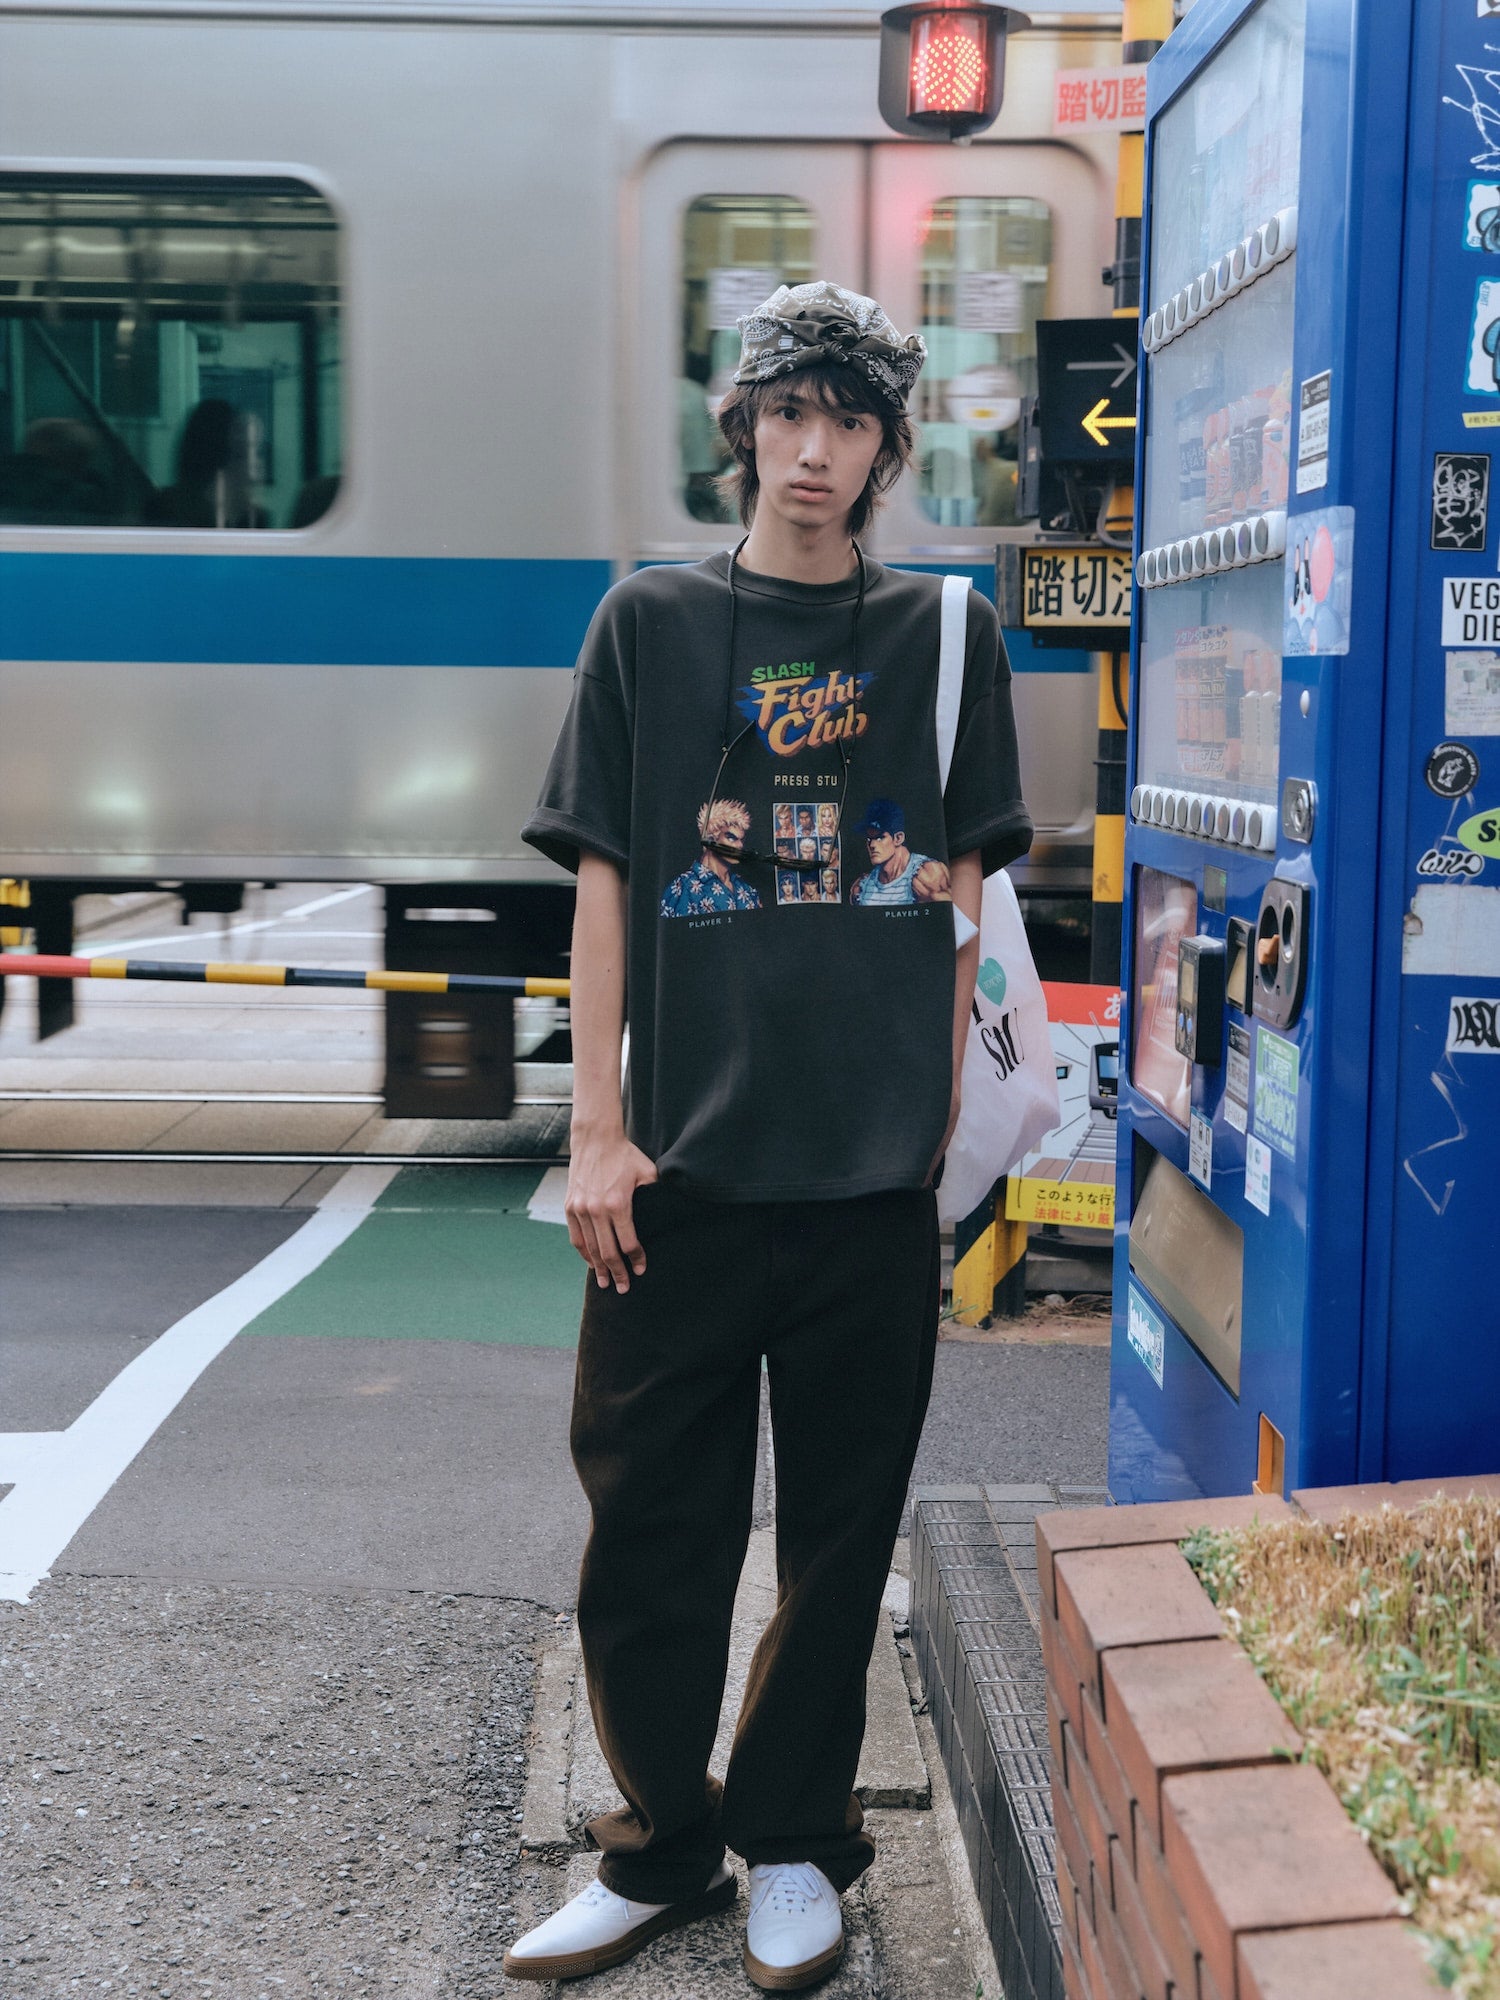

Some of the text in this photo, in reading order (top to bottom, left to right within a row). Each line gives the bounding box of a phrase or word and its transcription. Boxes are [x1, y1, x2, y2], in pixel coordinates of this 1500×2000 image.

[1449, 582, 1500, 610] VEG
[751, 661, 815, 683] SLASH
[751, 670, 864, 731] Fight
[767, 703, 870, 758] Club
[774, 775, 838, 786] PRESS STU
[885, 909, 919, 918] PLAYER
[688, 919, 722, 929] PLAYER
[1037, 1188, 1115, 1206] このような行
